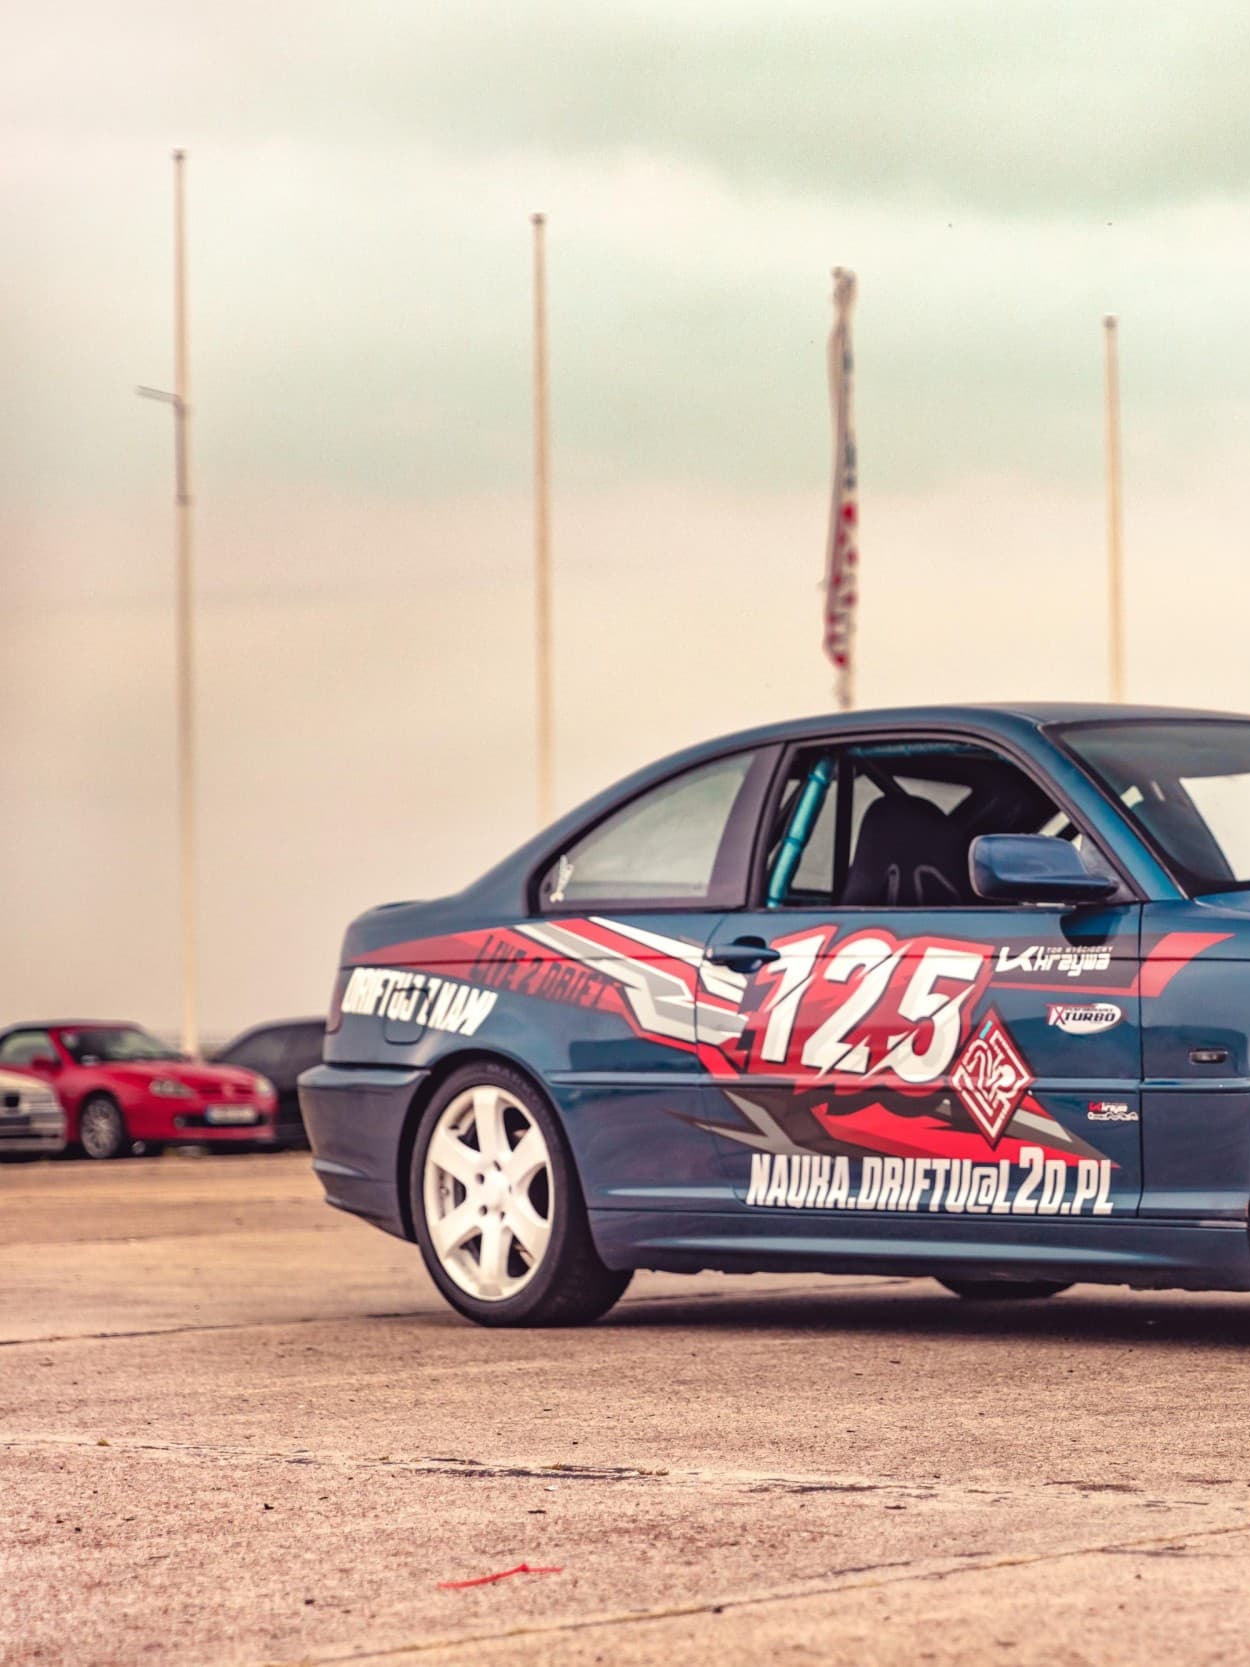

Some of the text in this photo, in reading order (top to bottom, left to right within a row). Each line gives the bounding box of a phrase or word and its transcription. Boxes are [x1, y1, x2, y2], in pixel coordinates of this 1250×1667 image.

[516, 956, 544, 993] 2
[757, 934, 984, 1083] 125
[747, 1147, 1114, 1215] NAUKA.DRIFTU@L2D.PL
